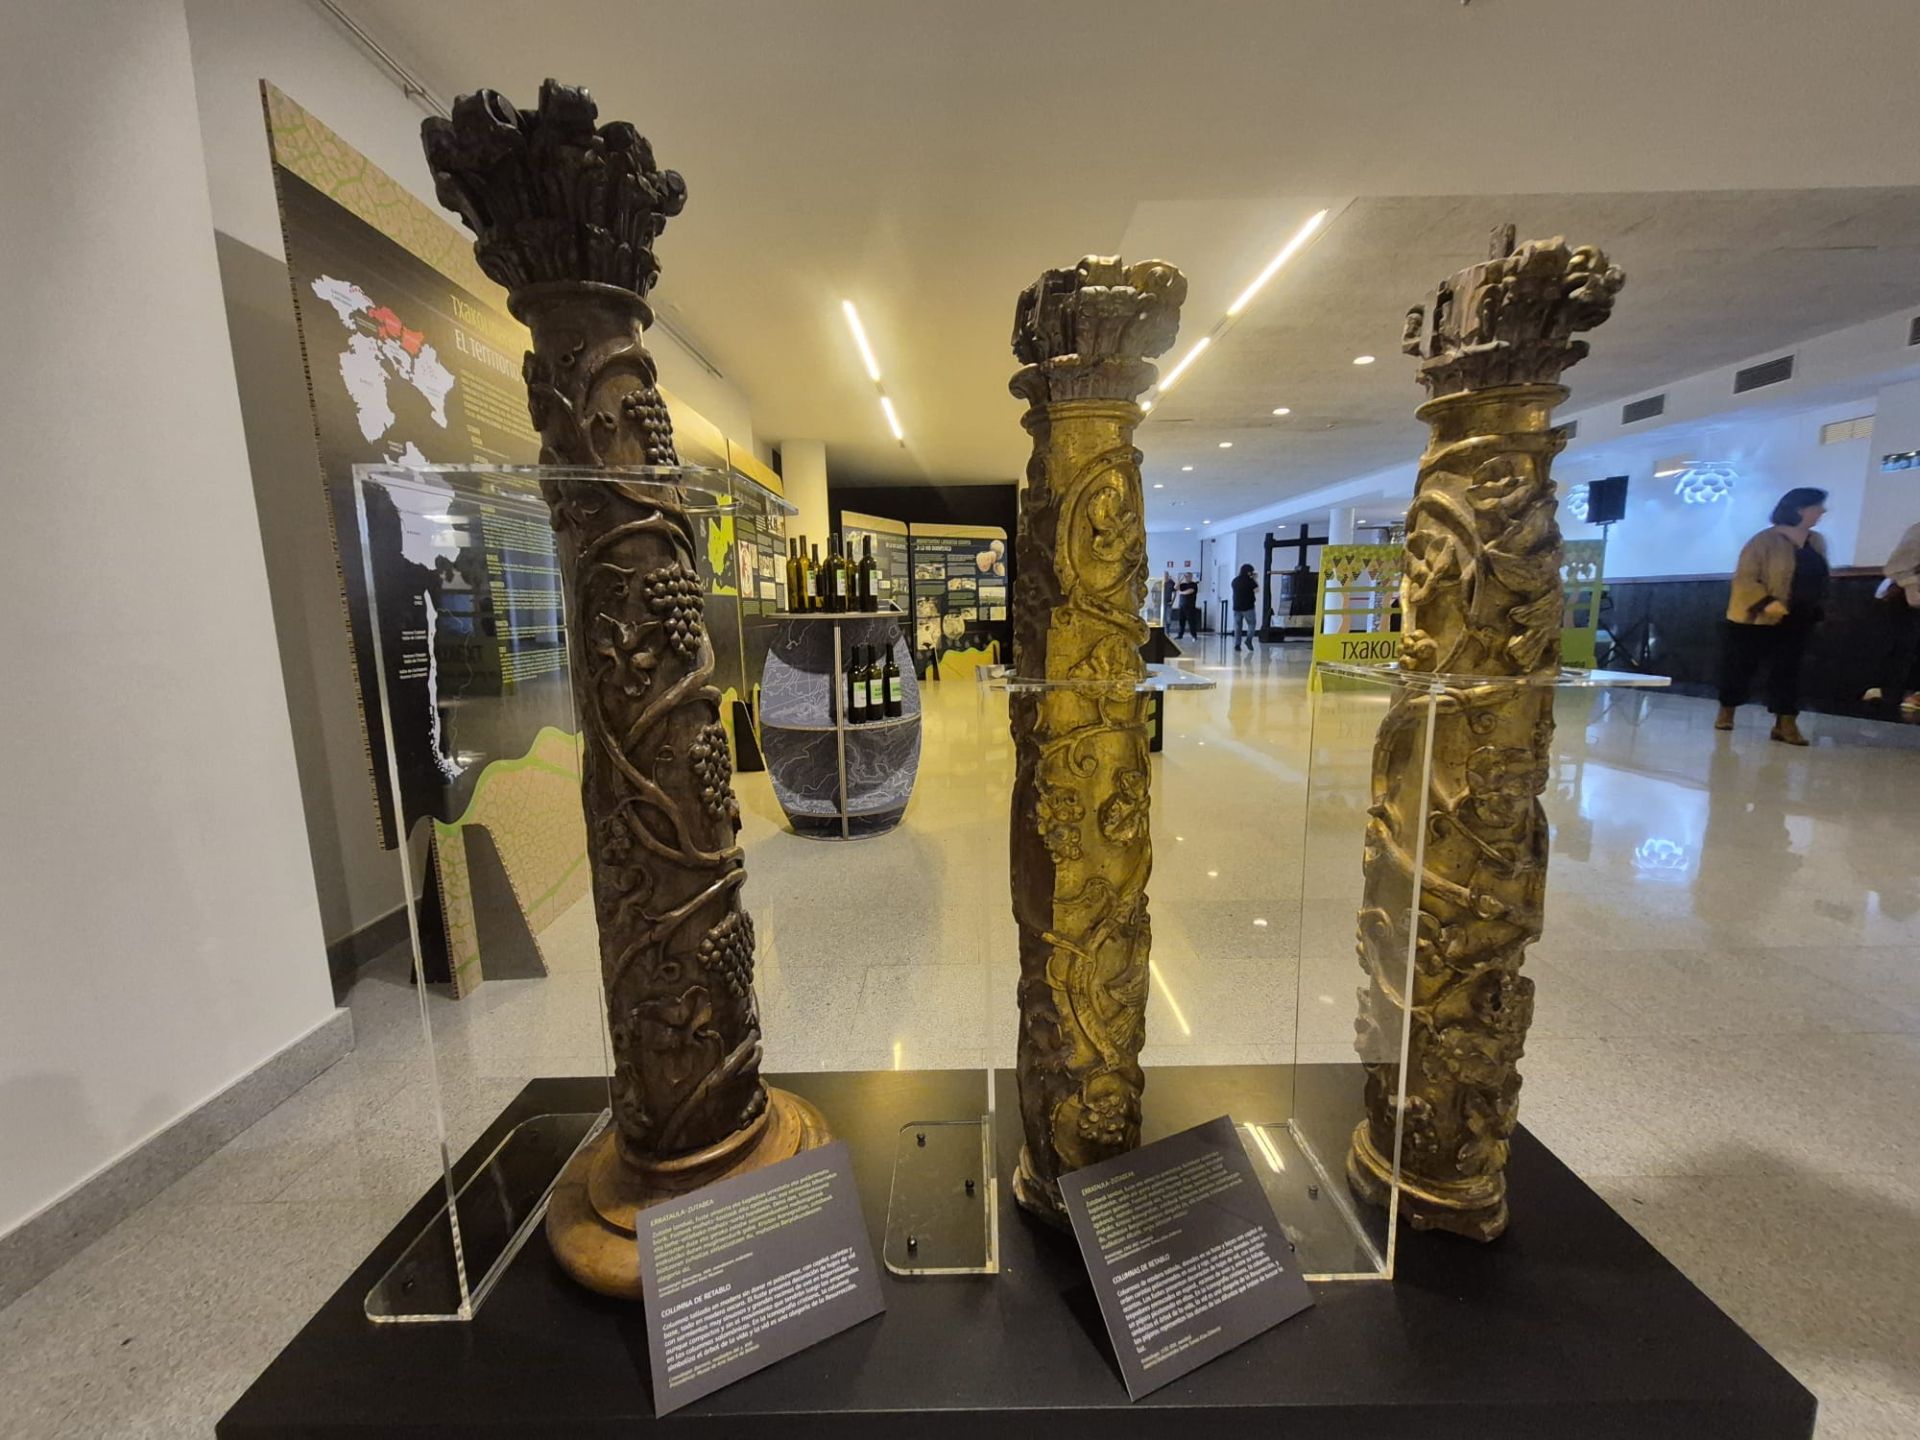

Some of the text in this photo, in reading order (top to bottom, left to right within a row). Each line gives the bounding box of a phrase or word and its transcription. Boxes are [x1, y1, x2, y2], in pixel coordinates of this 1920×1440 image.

[661, 1300, 693, 1318] COLUMNA
[694, 1295, 702, 1304] DE
[704, 1283, 731, 1299] RETABLO
